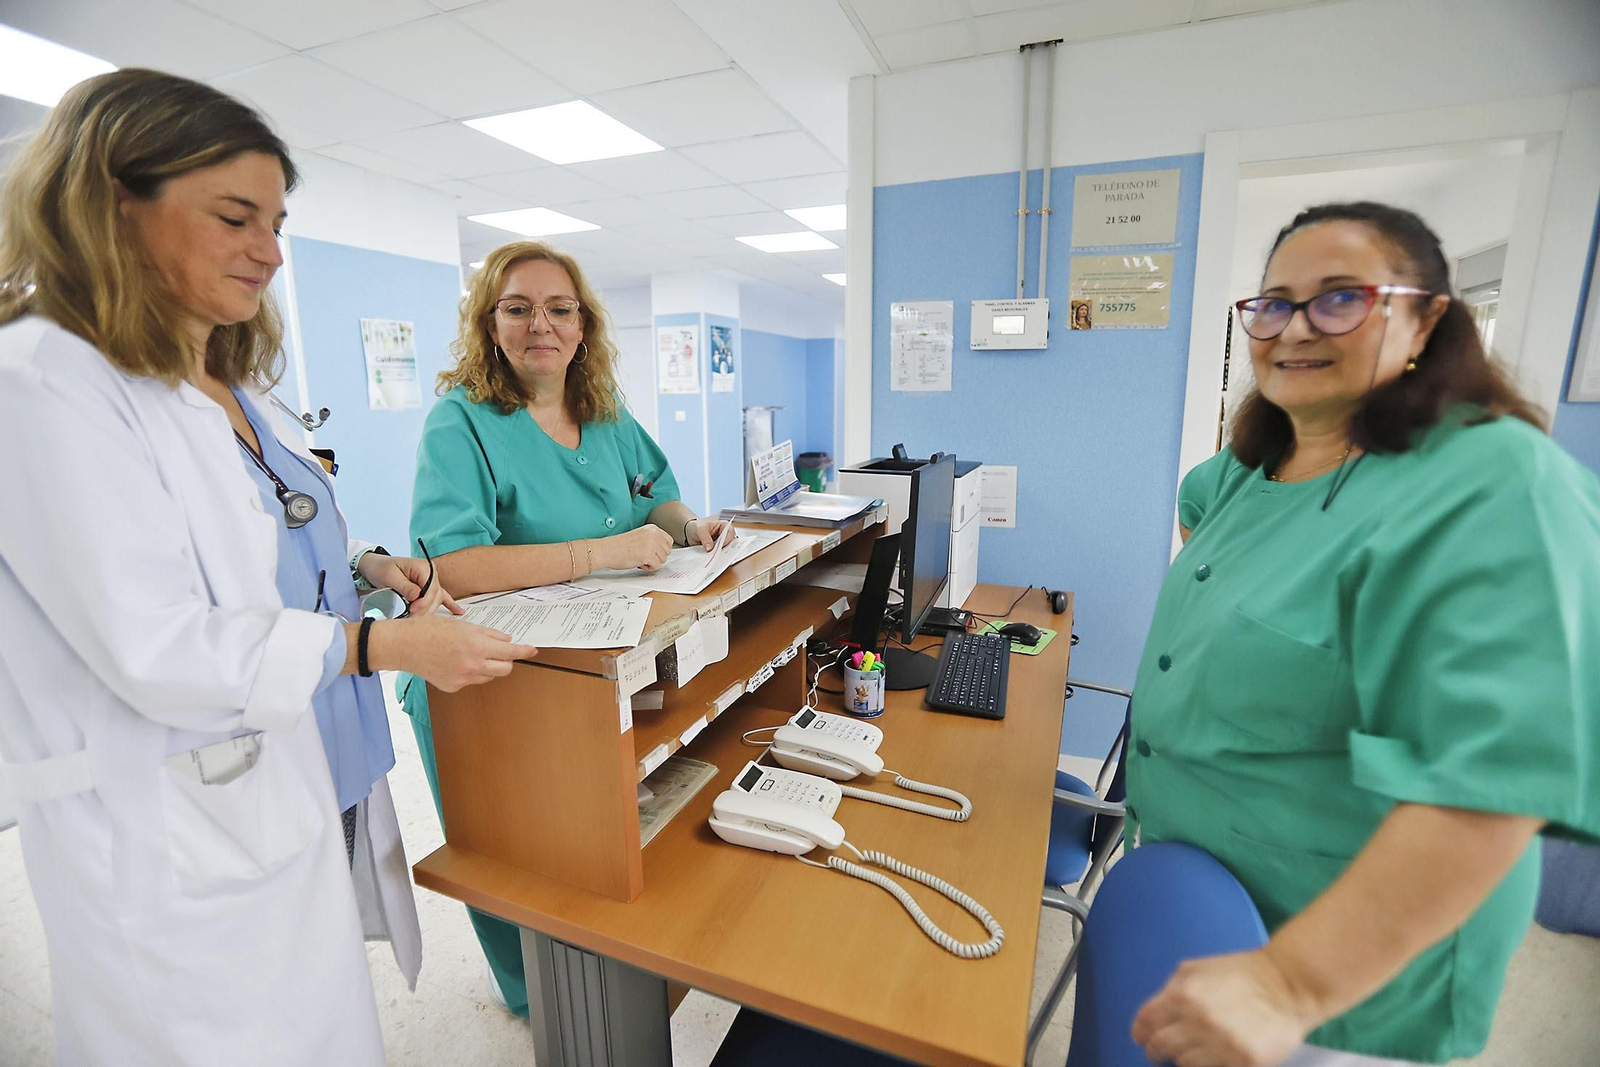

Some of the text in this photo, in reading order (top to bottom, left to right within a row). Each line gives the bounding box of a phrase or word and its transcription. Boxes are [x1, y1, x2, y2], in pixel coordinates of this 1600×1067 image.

[1092, 179, 1161, 192] TELÉFONO DE
[1104, 192, 1145, 202] PARADA
[1105, 214, 1141, 225] 21 52 00
[1099, 302, 1136, 313] 755775
